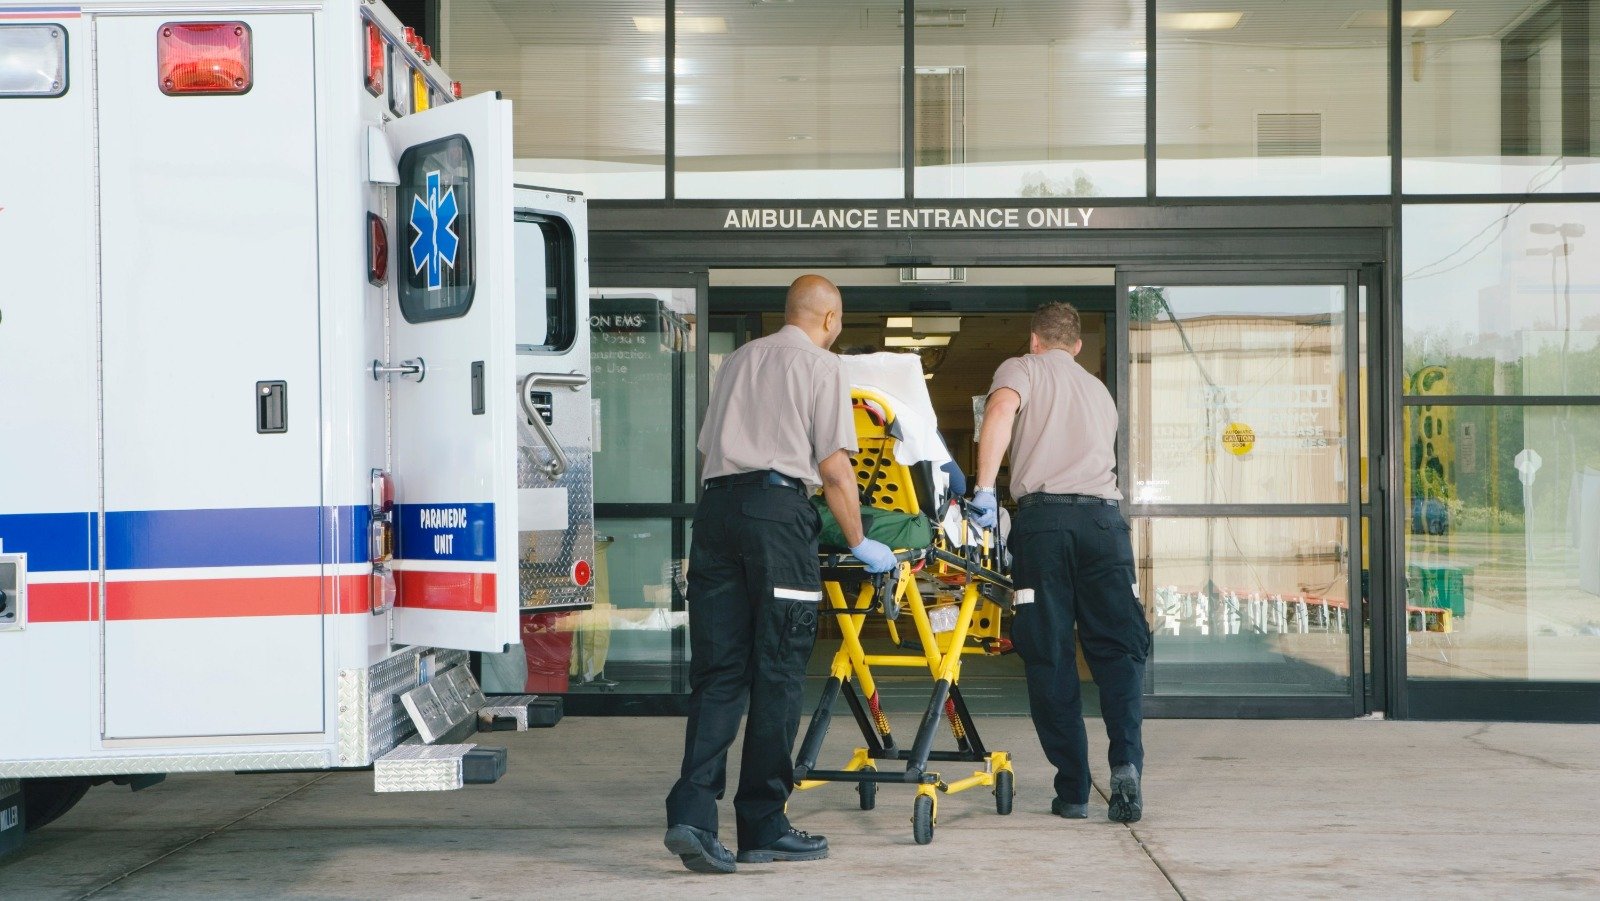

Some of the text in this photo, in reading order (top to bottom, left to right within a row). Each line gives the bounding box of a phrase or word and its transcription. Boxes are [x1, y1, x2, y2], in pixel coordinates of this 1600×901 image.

[723, 207, 1094, 229] AMBULANCE ENTRANCE ONLY
[420, 508, 467, 529] PARAMEDIC
[434, 534, 454, 555] UNIT
